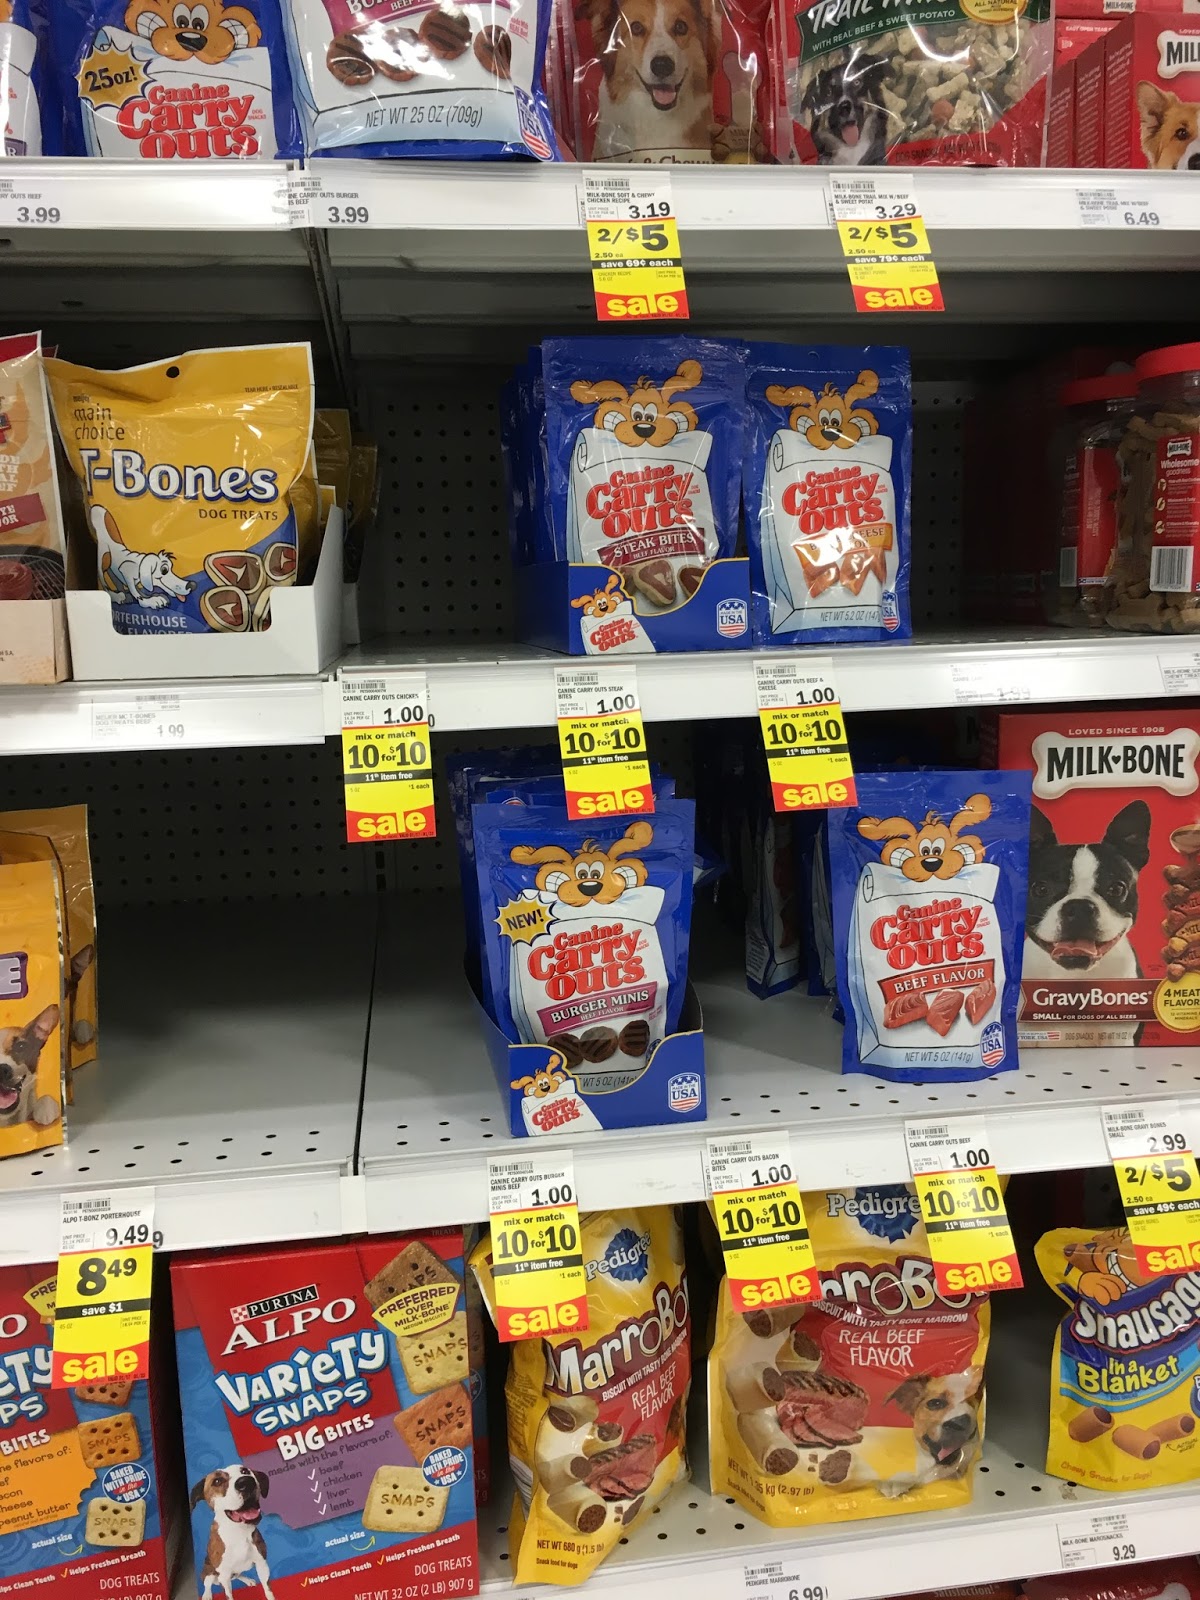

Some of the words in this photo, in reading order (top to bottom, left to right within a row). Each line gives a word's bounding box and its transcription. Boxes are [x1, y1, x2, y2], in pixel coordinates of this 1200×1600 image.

[148, 83, 230, 104] Canine
[117, 94, 255, 140] Carry
[365, 108, 386, 128] NET
[389, 106, 407, 125] WT
[410, 106, 424, 124] 25
[427, 105, 444, 123] OZ
[445, 106, 483, 128] (709g)
[16, 206, 61, 223] 3.99
[328, 206, 369, 223] 3.99
[628, 202, 671, 219] 3.19
[875, 203, 917, 219] 3.29
[1124, 212, 1160, 225] 6.49
[597, 224, 669, 252] 2/$5
[848, 223, 918, 249] 2/$5
[648, 259, 673, 267] each
[901, 255, 925, 263] each
[606, 294, 679, 317] sale
[864, 287, 934, 309] sale
[74, 403, 112, 421] main
[74, 425, 125, 440] choice
[79, 448, 279, 503] T-Bones
[609, 464, 675, 488] Canine
[805, 465, 862, 487] Canine
[586, 472, 695, 519] Carry
[782, 472, 880, 516] Carry
[199, 508, 227, 519] DOG
[232, 508, 278, 520] TREATS
[614, 537, 656, 558] STEAK
[659, 532, 696, 546] BITES
[597, 694, 636, 714] 1.00
[796, 687, 835, 705] 1.00
[384, 705, 424, 725] 1.00
[802, 710, 829, 718] match
[355, 732, 372, 740] mix
[387, 730, 416, 739] match
[597, 756, 613, 764] item
[785, 748, 799, 756] 11th
[800, 747, 816, 755] item
[577, 790, 645, 815] sale
[783, 782, 848, 807] sale
[357, 811, 427, 838] sale
[506, 909, 544, 931] NEW!
[896, 897, 962, 921] Canine
[553, 922, 624, 950] Canine
[870, 905, 983, 950] Carry
[527, 929, 642, 980] Carry
[894, 975, 928, 994] BEEF
[933, 967, 985, 985] FLAVOR
[1032, 988, 1148, 1010] GravyBones
[1163, 989, 1171, 997] 4
[1173, 989, 1200, 998] MEAT
[550, 999, 607, 1024] BURGER
[611, 989, 649, 1009] MINIS
[580, 1012, 596, 1021] BEEF
[596, 1006, 624, 1018] FLAVOR
[905, 1053, 920, 1062] NET
[921, 1052, 933, 1061] WT
[934, 1052, 940, 1061] 5
[940, 1052, 951, 1062] OZ
[951, 1051, 974, 1063] (141g)
[671, 1087, 698, 1101] USA
[1147, 1133, 1186, 1153] 2.99
[950, 1149, 990, 1168] 1.00
[751, 1164, 792, 1186] 1.00
[928, 1179, 944, 1187] mix
[958, 1174, 985, 1184] match
[531, 1184, 572, 1206] 1.00
[727, 1197, 744, 1205] mix
[758, 1191, 787, 1201] match
[1133, 1206, 1155, 1216] save
[1156, 1203, 1176, 1213] 49¢
[1178, 1200, 1200, 1210] each
[106, 1224, 148, 1246] 9.49
[585, 1231, 652, 1281] Pedigree
[945, 1261, 1012, 1291] sale
[741, 1275, 812, 1306] sale
[82, 1306, 106, 1315] save
[108, 1302, 123, 1313] $1
[251, 1288, 316, 1316] PURINA
[378, 1286, 456, 1318] PREFERRED
[405, 1302, 434, 1316] OVER
[220, 1297, 356, 1356] ALPO
[394, 1304, 449, 1328] MILK-BONE
[508, 1303, 580, 1336] sale
[838, 1329, 881, 1345] REAL
[886, 1328, 926, 1345] BEEF
[412, 1337, 468, 1368] SNAPS
[850, 1345, 914, 1368] FLAVOR
[62, 1350, 138, 1383] sale
[1077, 1355, 1179, 1394] Blanket
[1128, 1360, 1138, 1372] a
[254, 1380, 368, 1432] SNAPS
[640, 1385, 675, 1422] FLAVOR
[415, 1405, 467, 1441] SNAPS
[1, 1428, 51, 1456] BITES
[87, 1433, 131, 1450] SNAPS
[276, 1425, 325, 1463] BIG
[324, 1413, 375, 1441] BITES
[429, 1449, 452, 1463] BAKED
[109, 1465, 134, 1481] BAKED
[323, 1471, 362, 1487] chicken
[441, 1474, 458, 1485] USA
[123, 1491, 141, 1502] USA
[327, 1486, 350, 1500] liver
[380, 1492, 435, 1508] SNAPS
[329, 1499, 354, 1512] lamb
[385, 1551, 406, 1563] Helps
[406, 1542, 436, 1556] Freshen
[436, 1533, 461, 1549] Breath
[1113, 1544, 1136, 1561] 9.29
[308, 1573, 329, 1586] Helps
[330, 1569, 351, 1581] Clean
[351, 1562, 372, 1574] Teeth
[414, 1562, 436, 1577] DOG
[438, 1556, 473, 1573] TREATS
[100, 1578, 122, 1590] DOG
[125, 1571, 160, 1586] TREATS
